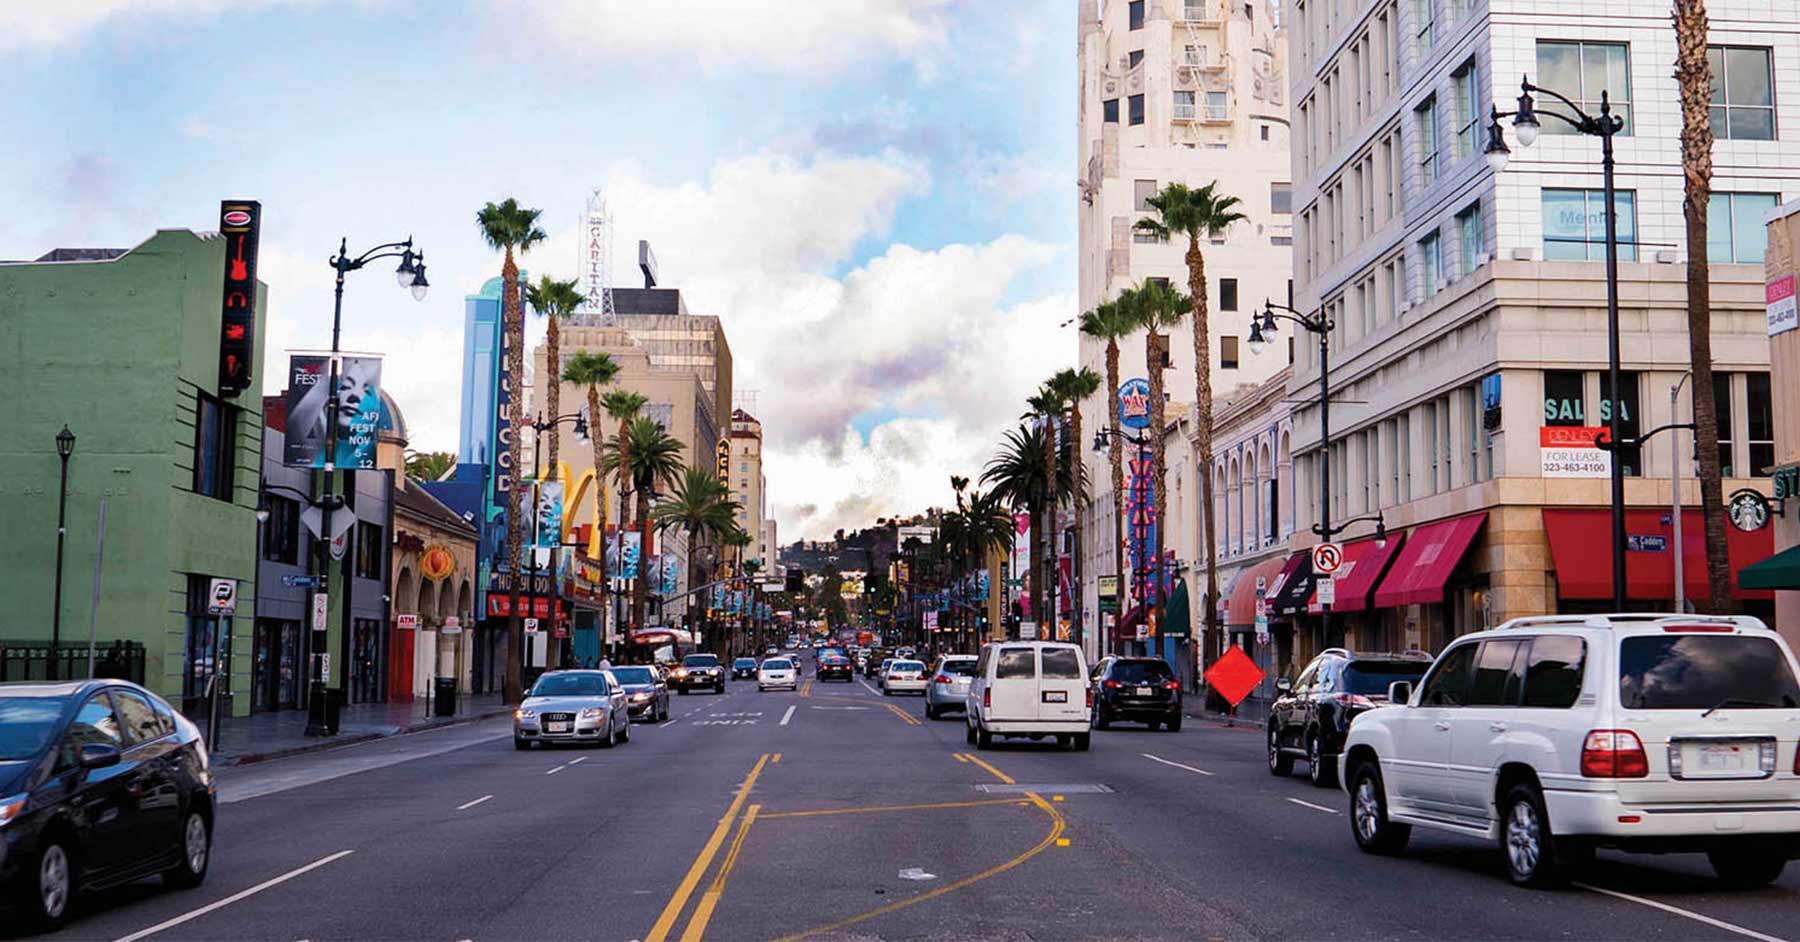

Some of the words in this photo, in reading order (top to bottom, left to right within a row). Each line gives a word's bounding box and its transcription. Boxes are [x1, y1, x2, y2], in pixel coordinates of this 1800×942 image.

[295, 374, 322, 385] FEST
[1123, 396, 1146, 408] WAX
[350, 424, 376, 433] FEST
[1548, 430, 1596, 440] DENLEY
[349, 436, 371, 445] NOV
[1546, 452, 1568, 462] FOR
[1570, 452, 1601, 462] LEASE
[359, 460, 373, 468] 12
[1775, 467, 1800, 499] ST
[1640, 536, 1664, 546] Cadden
[400, 616, 415, 624] ATM
